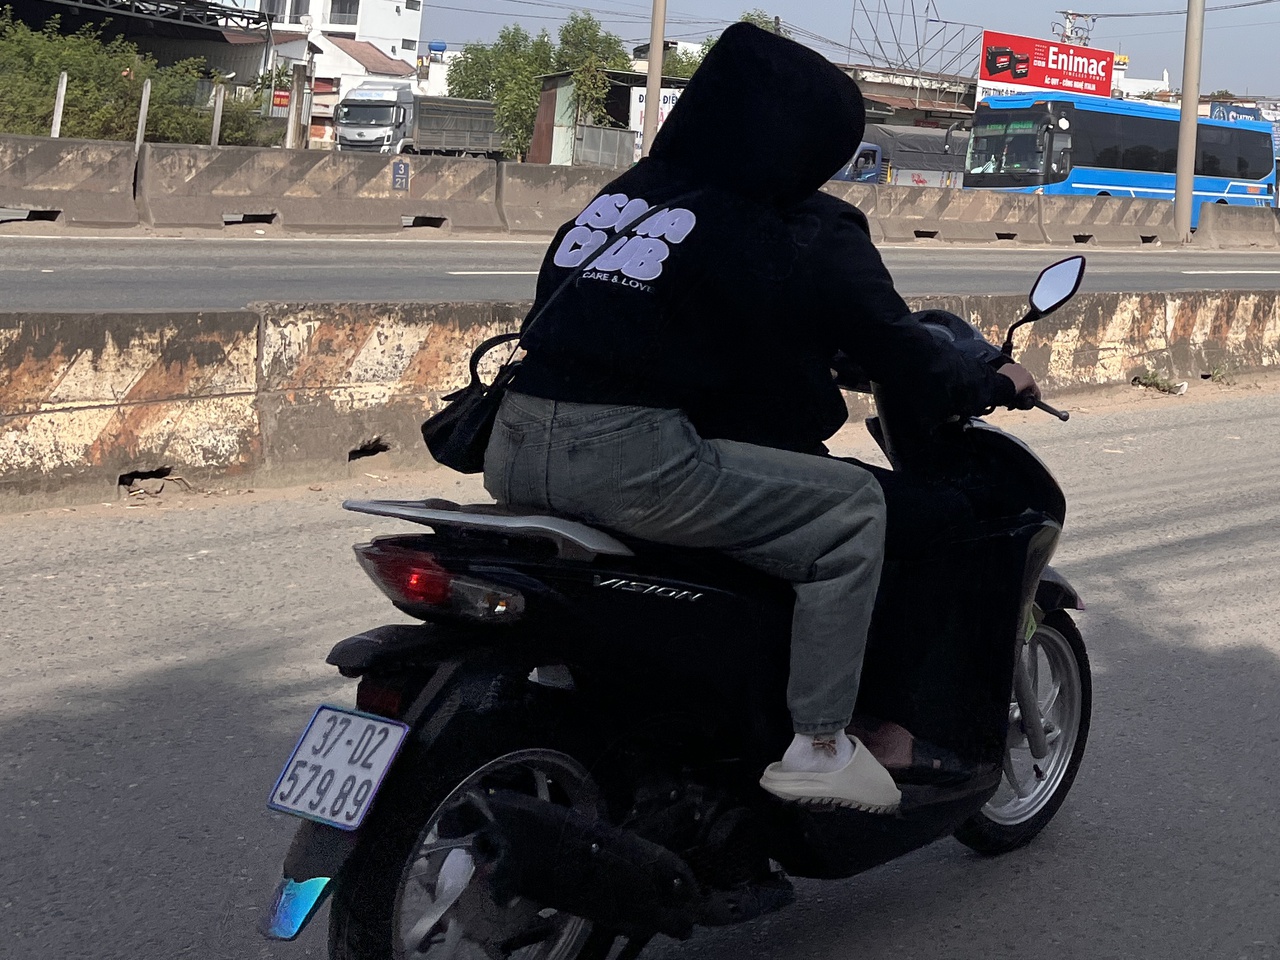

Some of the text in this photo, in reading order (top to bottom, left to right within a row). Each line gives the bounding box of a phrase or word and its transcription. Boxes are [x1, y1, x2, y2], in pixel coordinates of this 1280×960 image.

[1048, 46, 1107, 77] Enimac
[398, 163, 405, 175] 3
[395, 178, 406, 189] 21
[553, 225, 669, 281] CLUB
[582, 272, 655, 293] CARE & LOVE
[594, 575, 703, 601] VISION
[279, 760, 373, 820] 579.89
